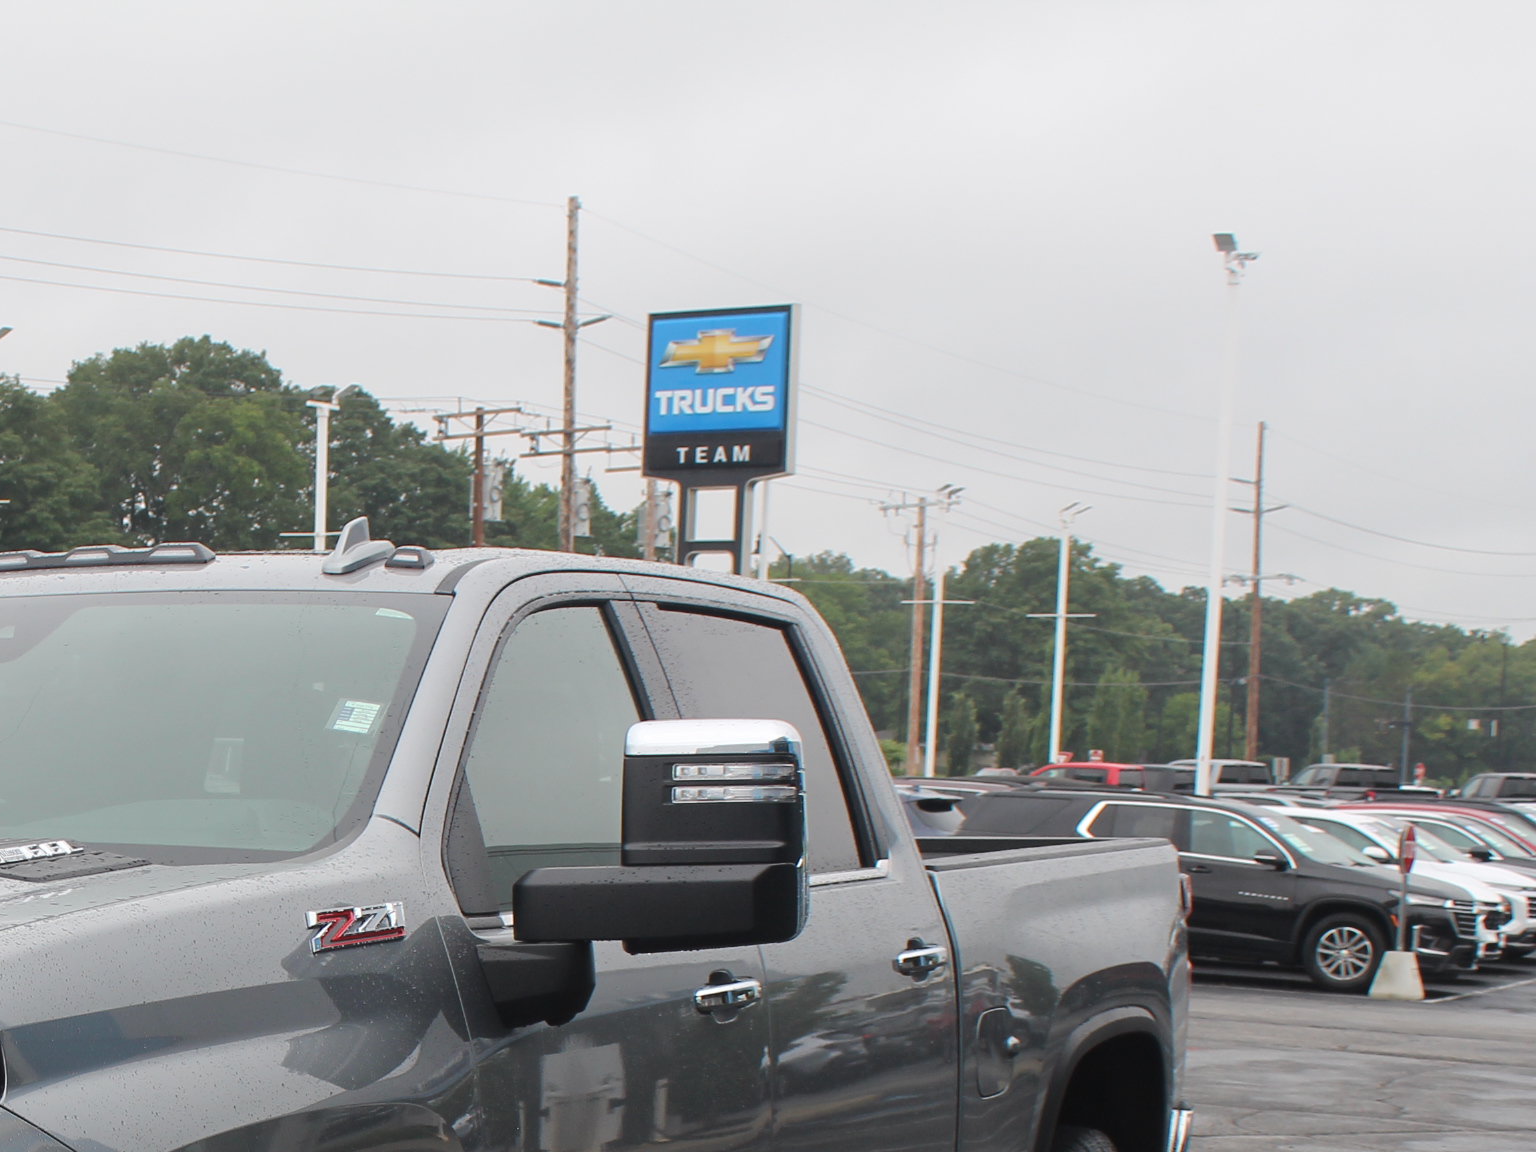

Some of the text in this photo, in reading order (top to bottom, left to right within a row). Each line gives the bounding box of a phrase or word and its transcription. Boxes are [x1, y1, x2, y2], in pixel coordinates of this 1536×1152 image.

[654, 385, 776, 415] TRUCKS
[676, 445, 751, 464] TEAM
[305, 901, 406, 955] Z71
